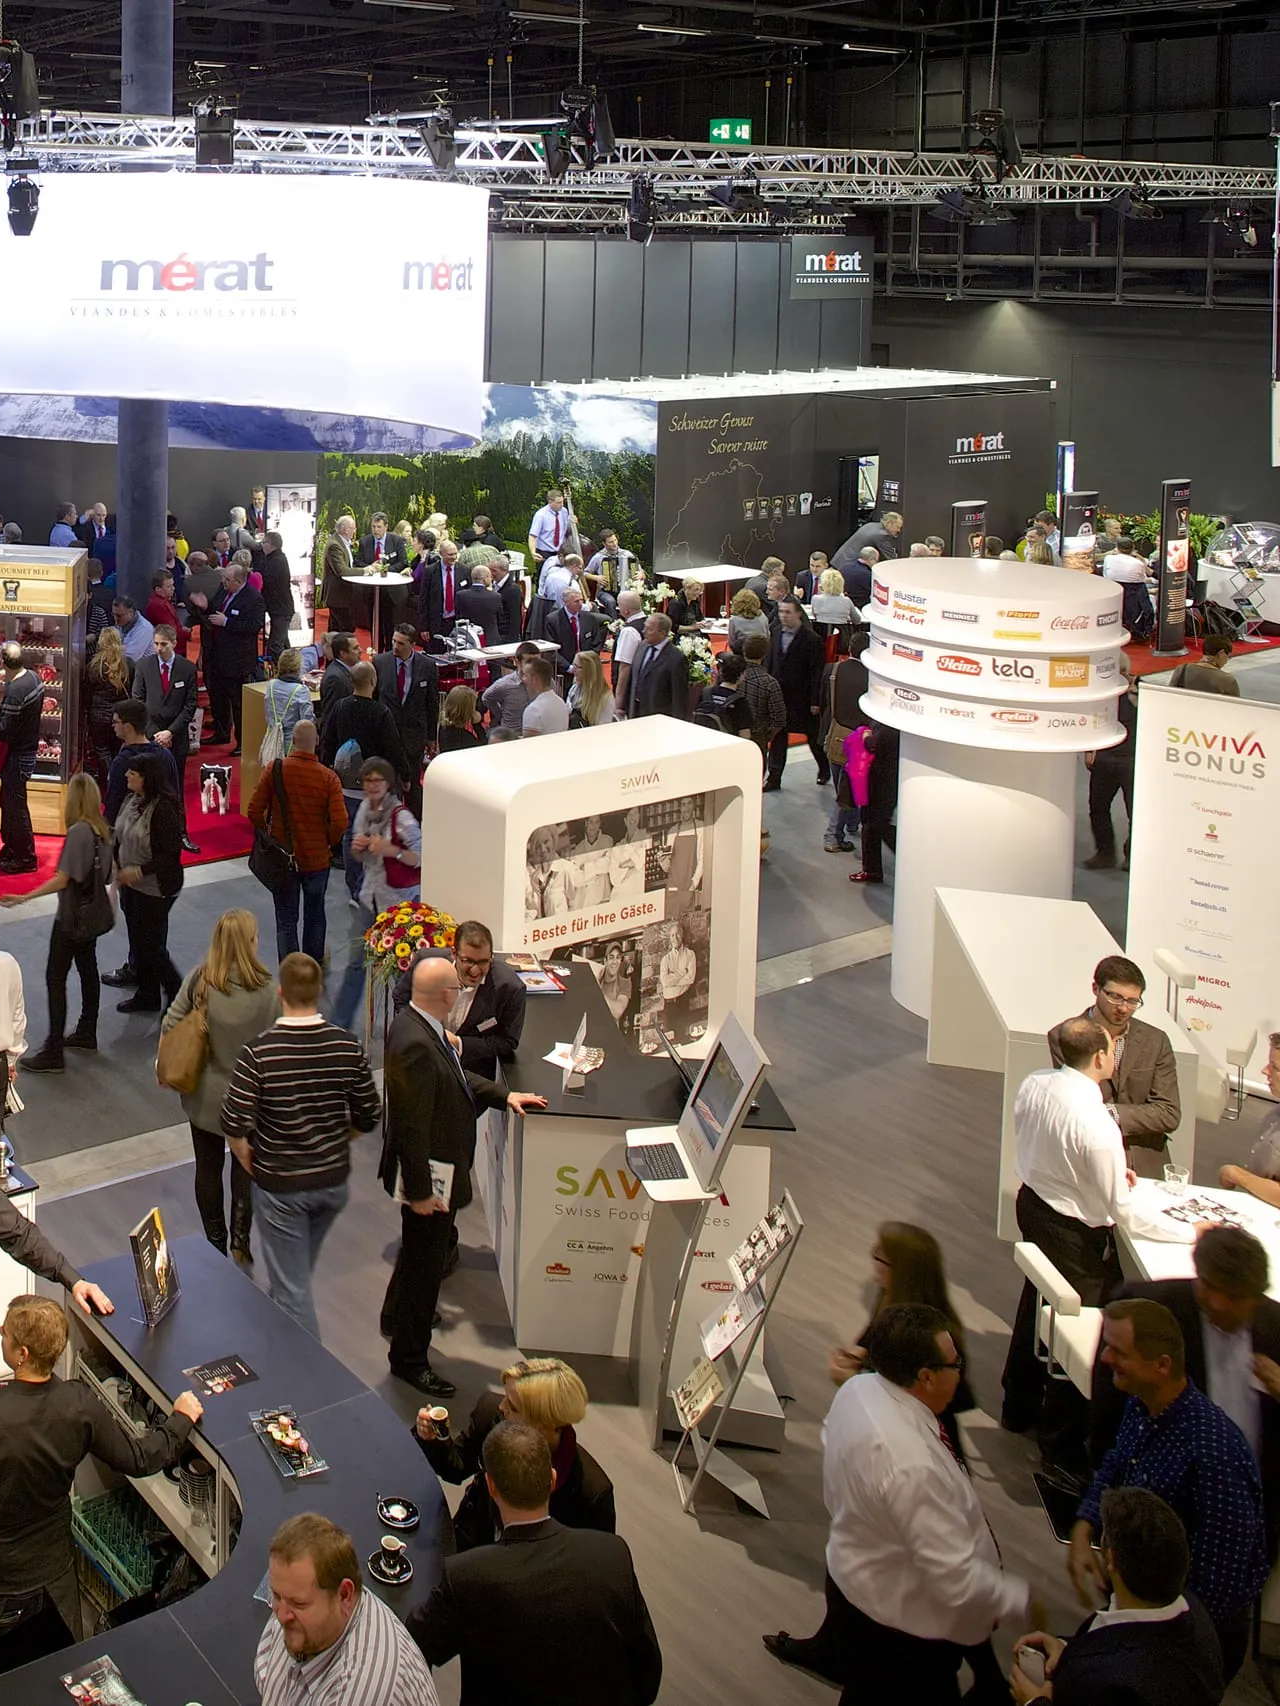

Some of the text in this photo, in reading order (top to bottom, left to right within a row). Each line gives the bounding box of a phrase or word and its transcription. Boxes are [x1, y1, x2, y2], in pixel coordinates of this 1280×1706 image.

[805, 248, 862, 271] mérat
[100, 252, 274, 292] mérat
[403, 254, 473, 291] mérat
[70, 307, 150, 317] VIANDES
[668, 411, 754, 436] Schweizer Genuss
[708, 437, 769, 454] Saveur suisse
[956, 431, 1004, 453] mérat
[893, 611, 925, 626] Jet-Cut
[938, 657, 980, 673] Heinz
[992, 657, 1034, 679] tela
[897, 689, 918, 700] Hero
[939, 706, 976, 719] mérat
[1047, 719, 1077, 728] JOWA
[1167, 728, 1266, 759] SAVIVA
[1166, 747, 1266, 779] BONUS
[620, 766, 660, 790] SAVIVA
[1194, 847, 1225, 860] schaerer
[532, 921, 568, 943] Beste
[571, 917, 589, 934] für
[593, 910, 616, 928] Ihre
[620, 901, 657, 920] Gäste.
[1197, 975, 1231, 989] MIGROL
[1184, 995, 1223, 1011] Hotelplan
[555, 1203, 650, 1222] Swiss Food
[587, 1243, 614, 1252] Angehrn
[593, 1273, 618, 1281] JOWA
